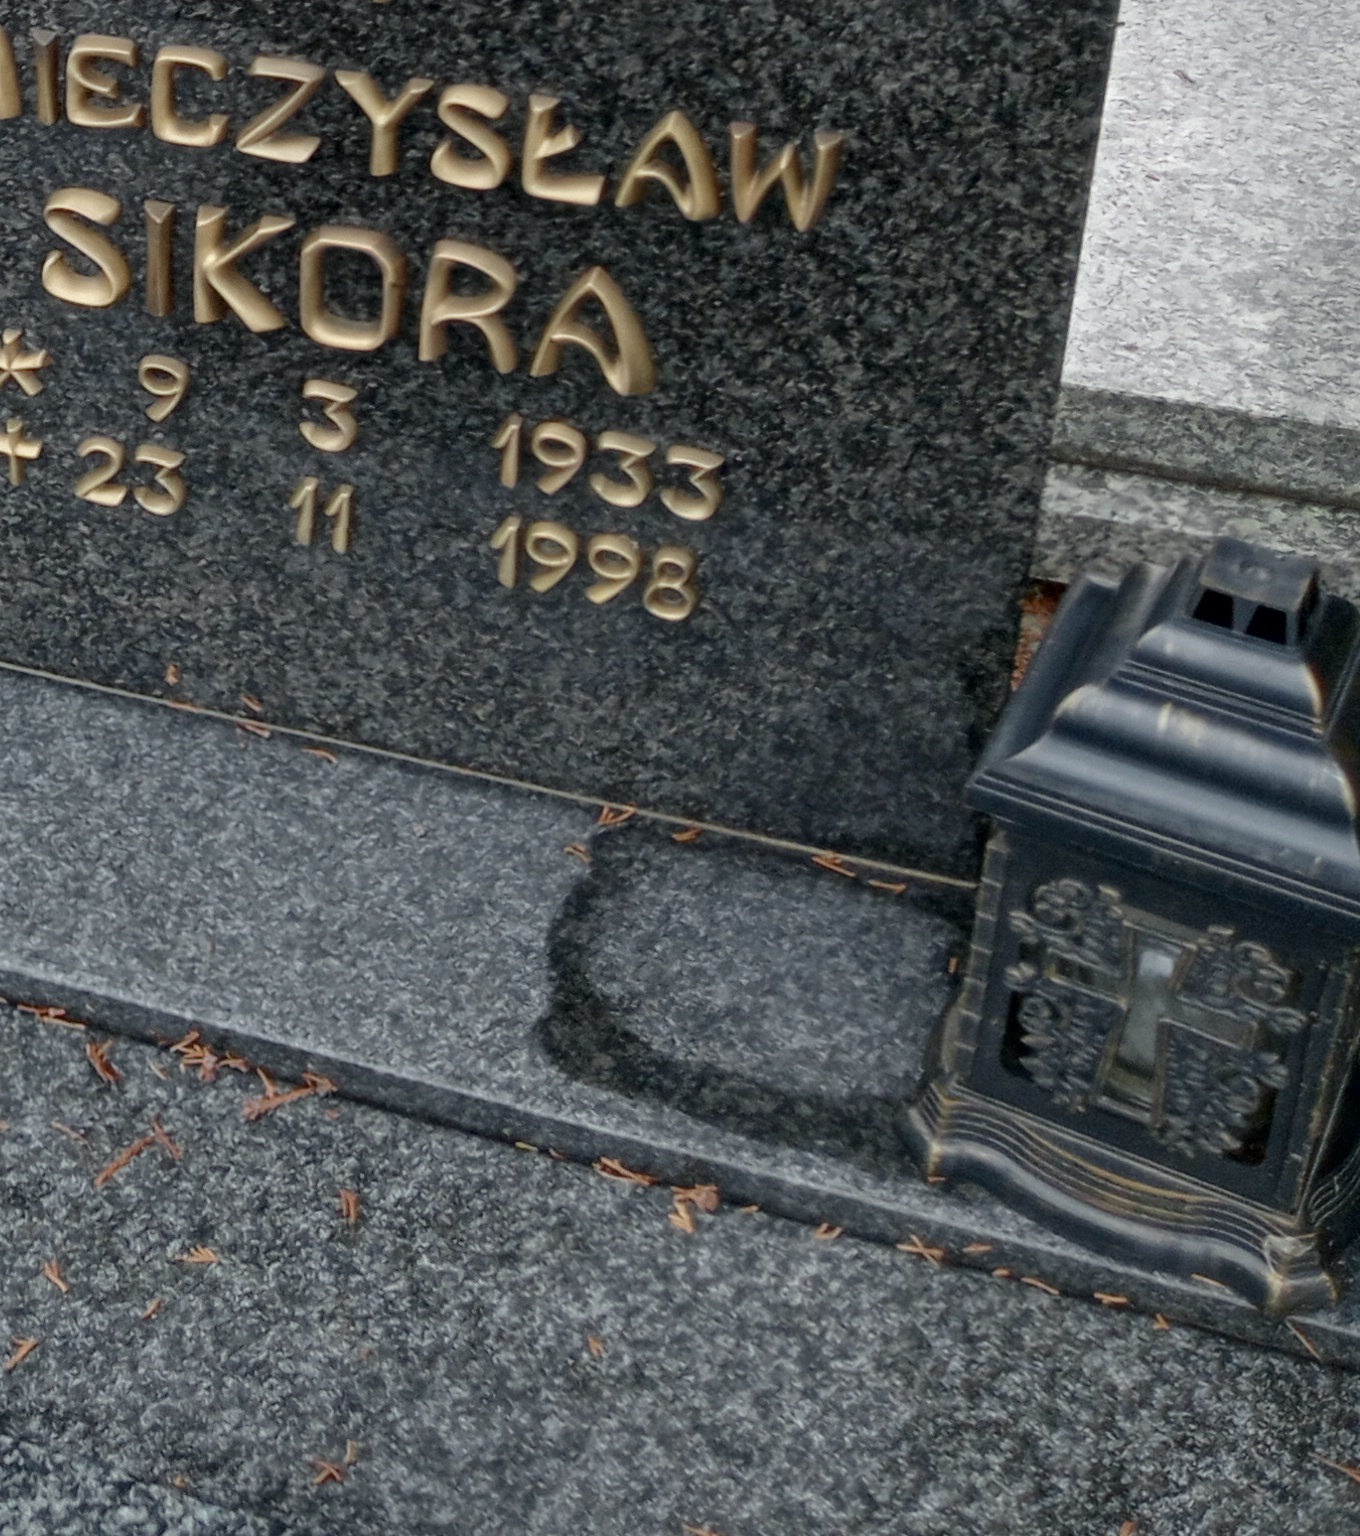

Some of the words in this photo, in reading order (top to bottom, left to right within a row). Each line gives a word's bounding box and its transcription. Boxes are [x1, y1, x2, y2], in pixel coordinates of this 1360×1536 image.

[41, 185, 658, 397] SIKORA
[76, 435, 190, 516] 23
[289, 475, 355, 553] 11
[491, 514, 700, 622] 1998
[138, 353, 191, 422] 9
[299, 378, 359, 453] 3
[492, 411, 726, 521] 1933
